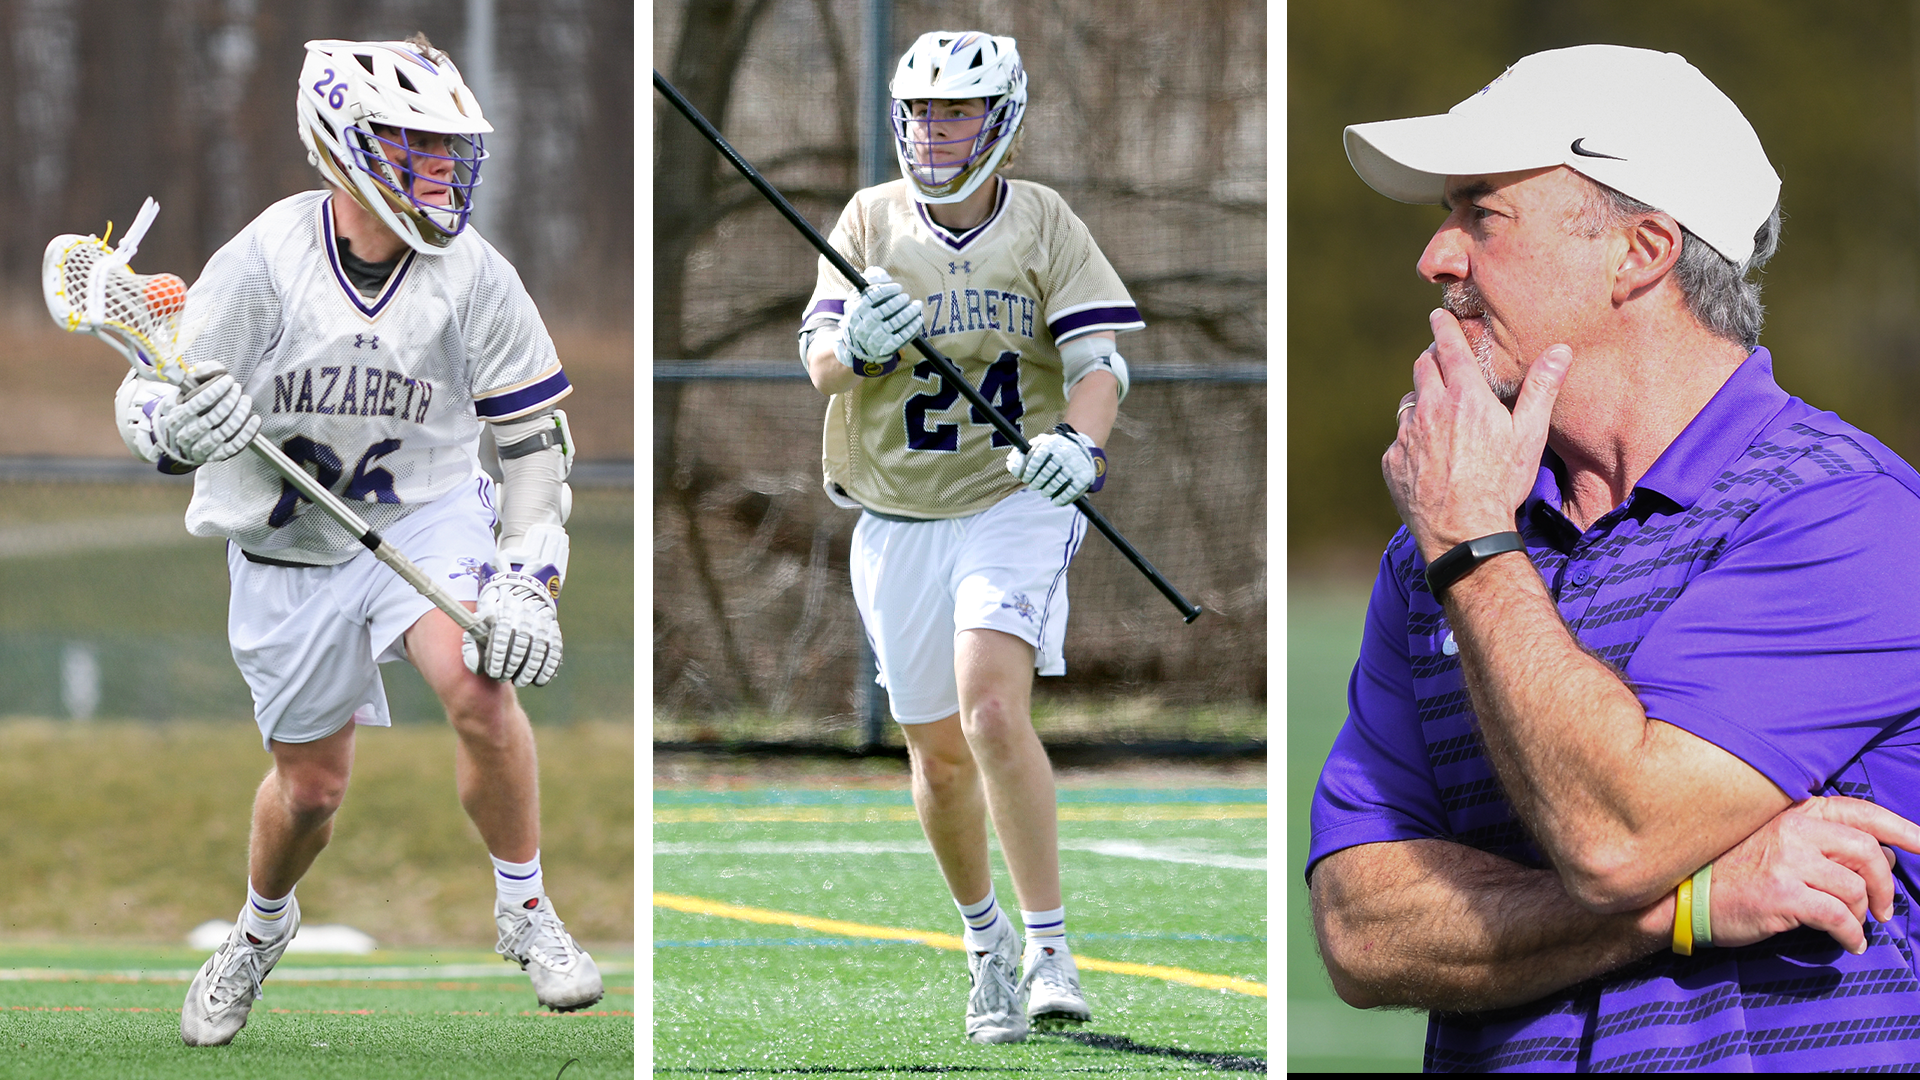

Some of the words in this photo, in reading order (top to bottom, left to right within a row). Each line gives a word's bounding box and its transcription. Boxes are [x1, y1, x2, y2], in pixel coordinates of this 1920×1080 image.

[312, 68, 349, 111] 26
[919, 288, 1036, 339] ZARETH
[272, 365, 433, 424] NAZARETH
[904, 350, 1026, 454] 24
[268, 433, 403, 529] 26
